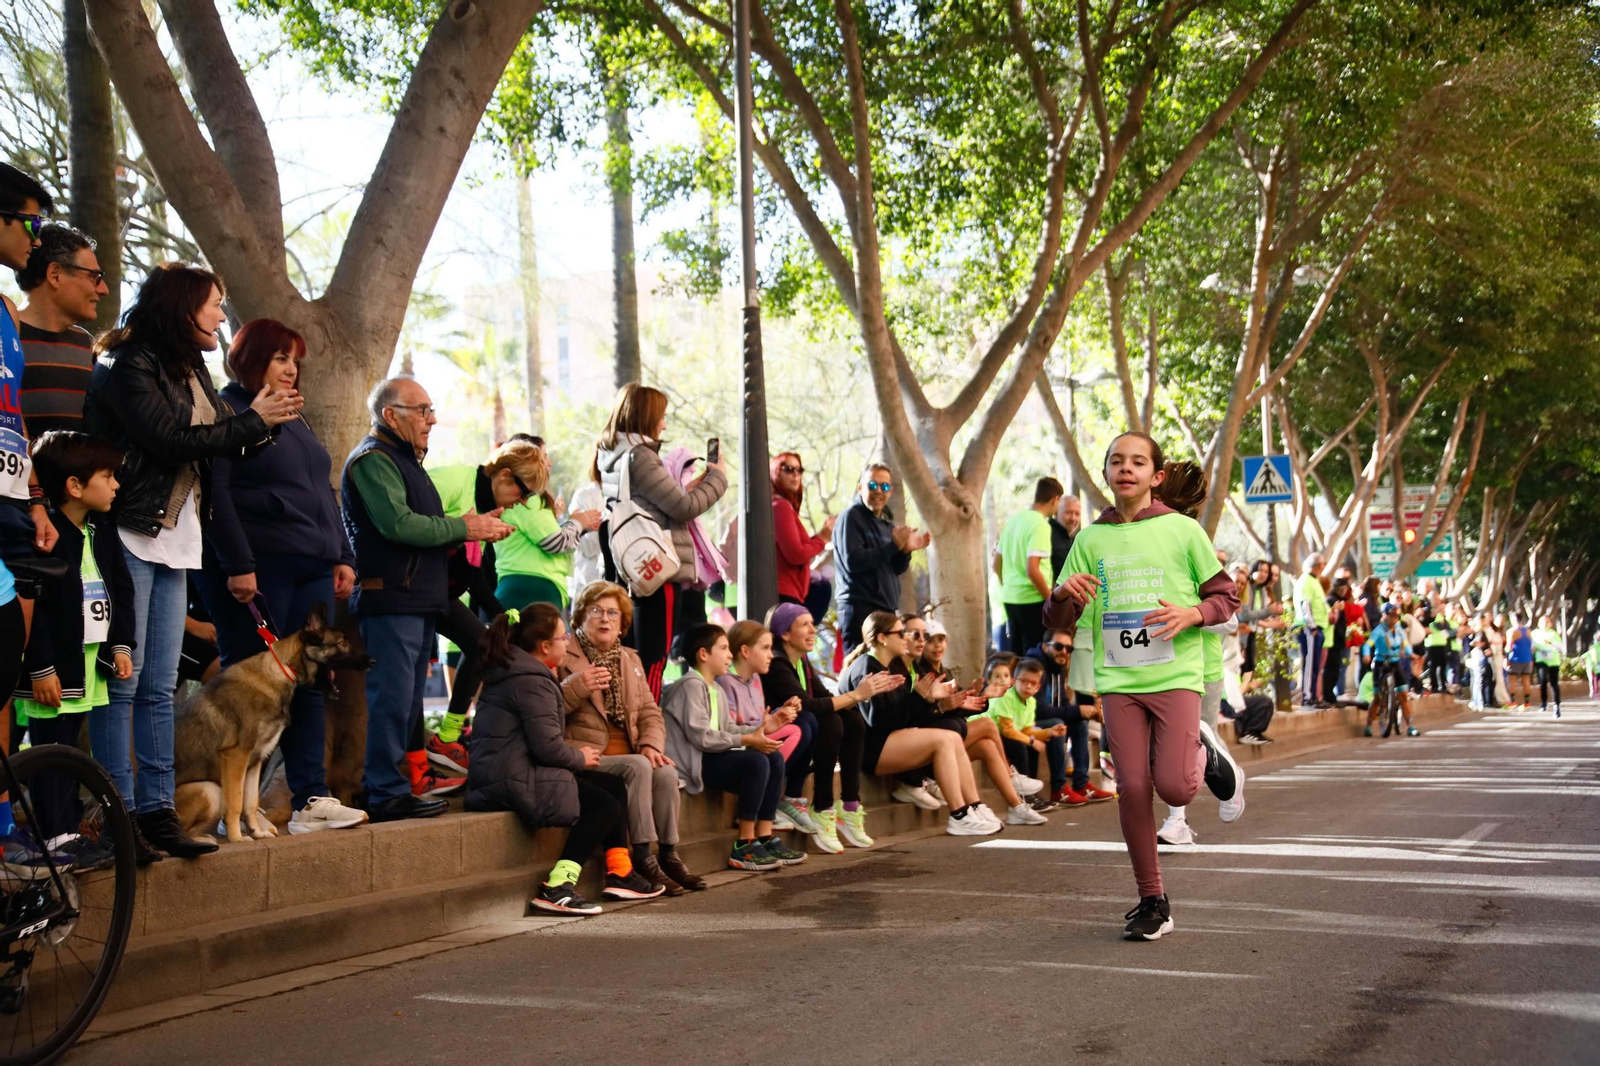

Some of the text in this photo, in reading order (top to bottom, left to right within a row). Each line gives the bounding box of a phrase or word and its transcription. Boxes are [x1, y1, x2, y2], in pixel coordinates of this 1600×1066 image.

[1108, 566, 1164, 580] En marcha
[1098, 558, 1109, 608] ALMERIA
[1110, 576, 1164, 591] contra el
[1111, 591, 1165, 606] cáncer
[1119, 628, 1150, 649] 64
